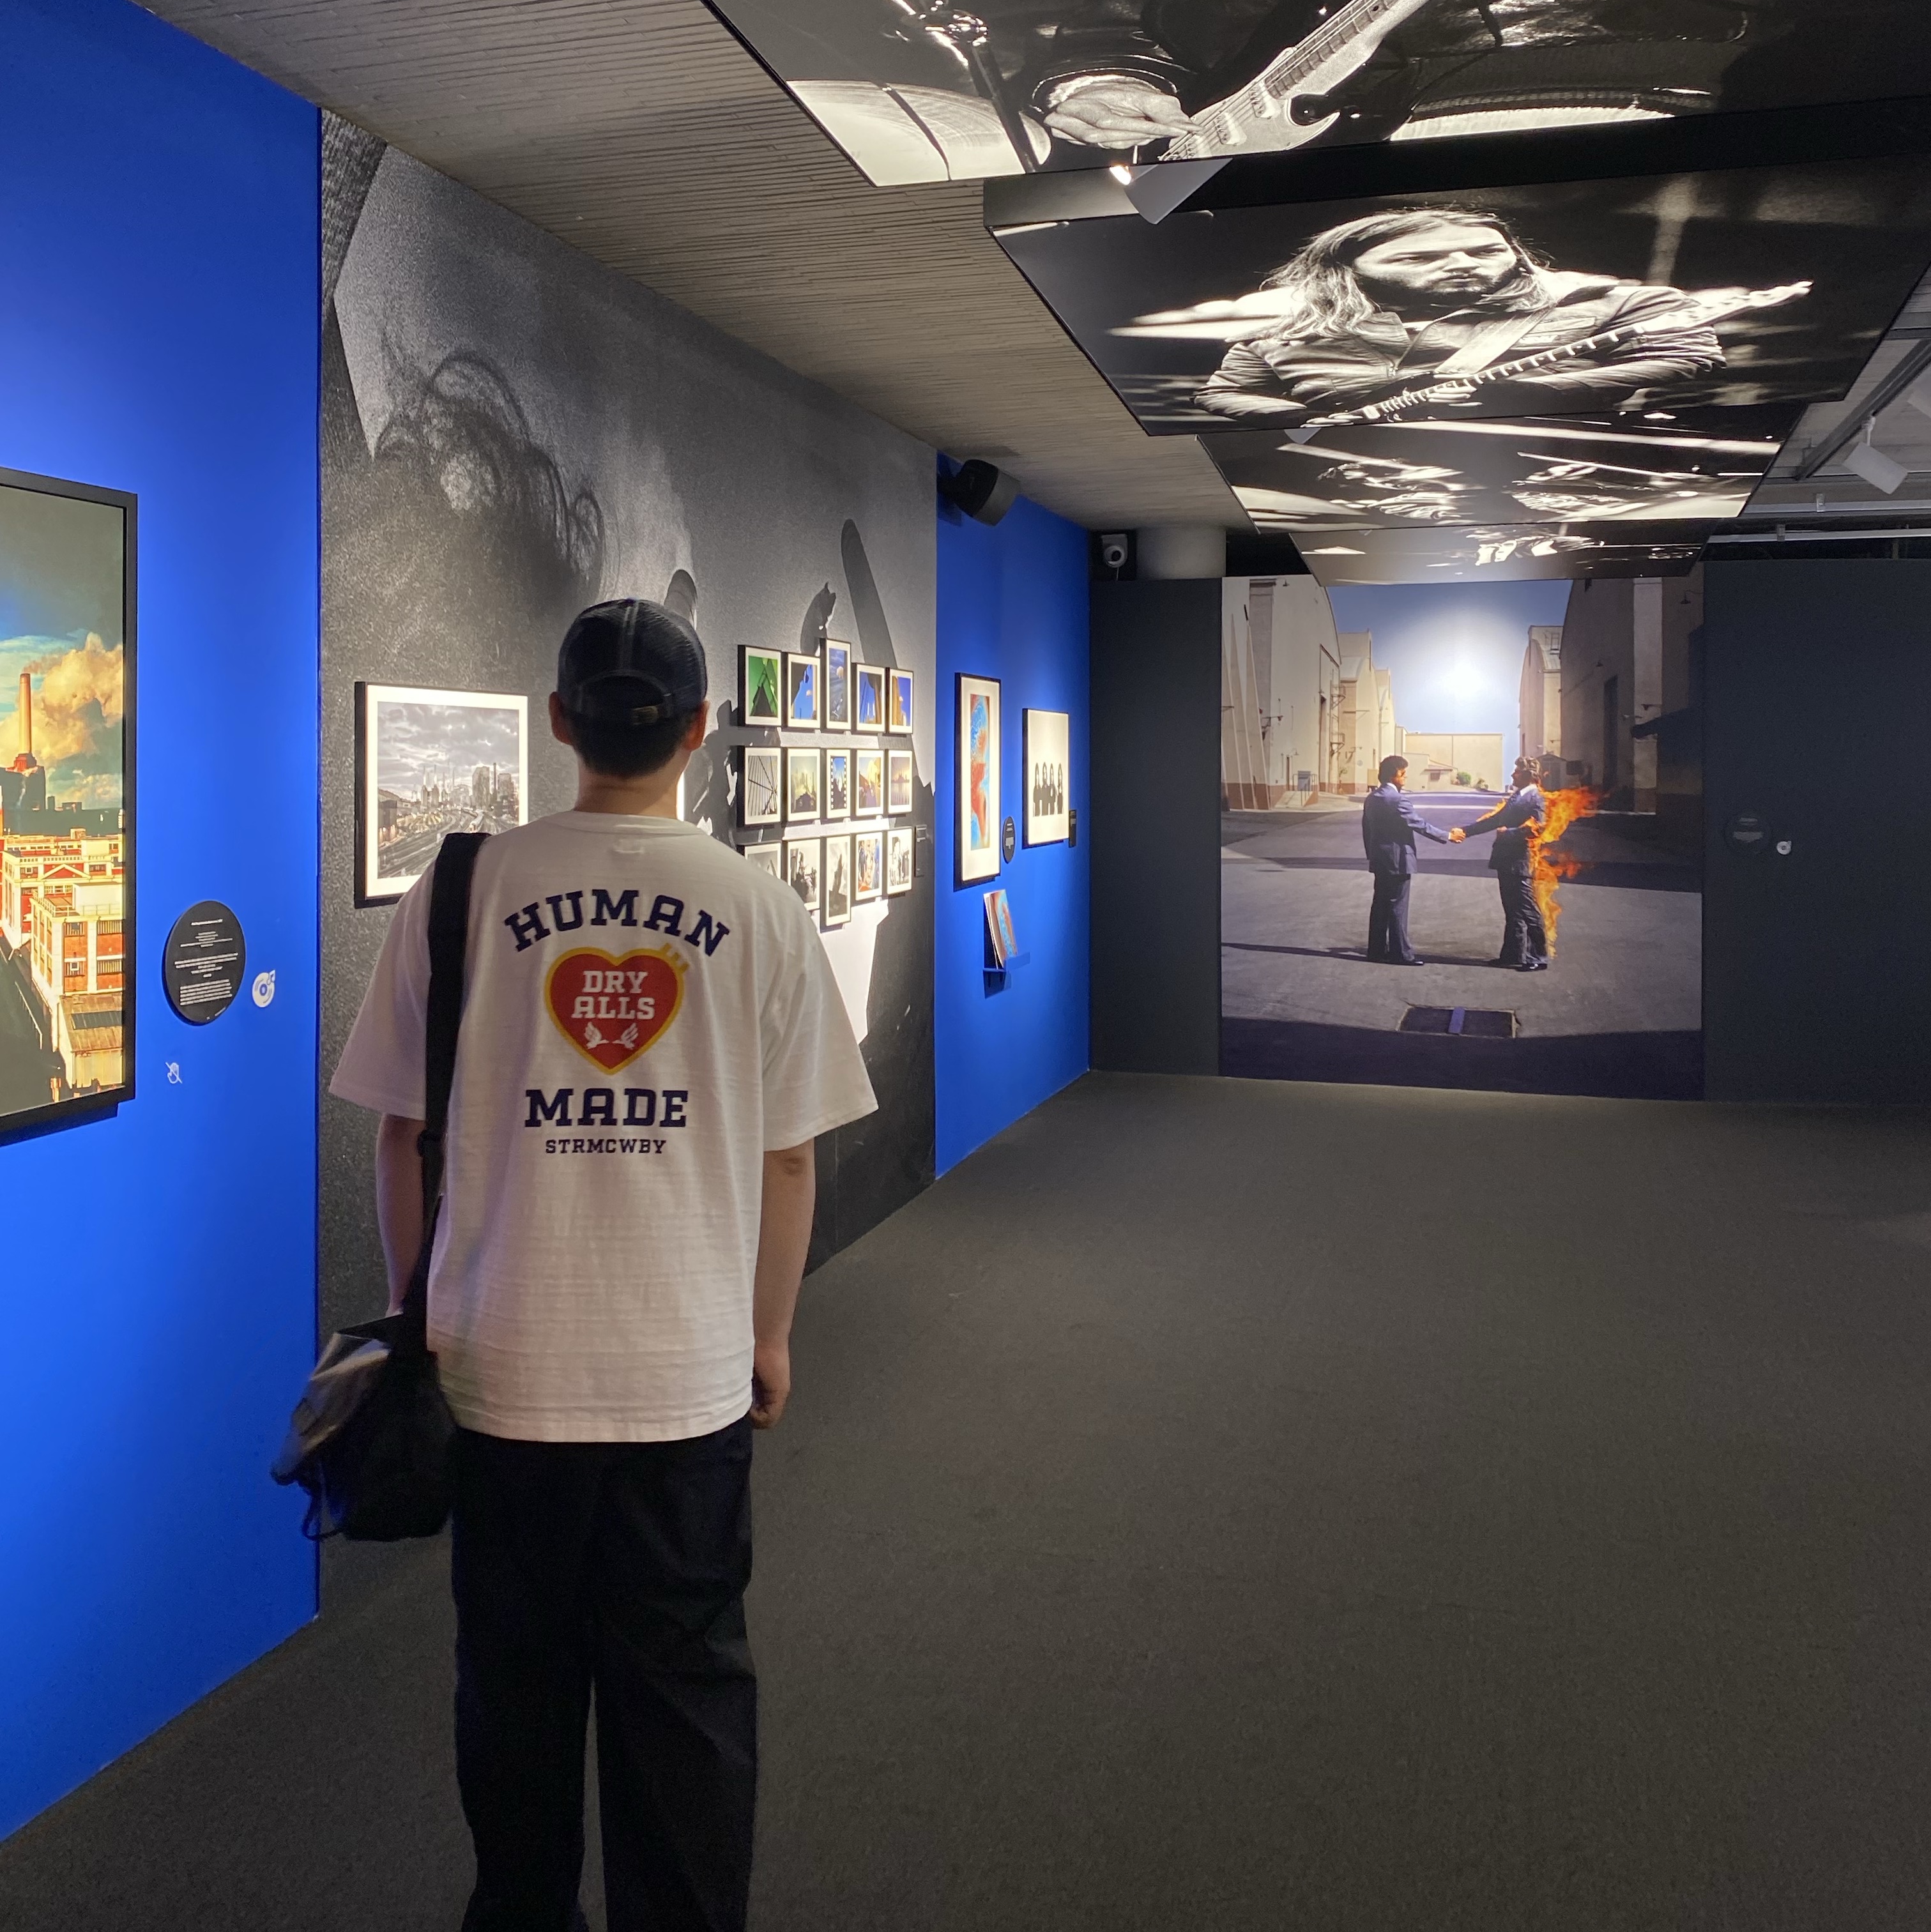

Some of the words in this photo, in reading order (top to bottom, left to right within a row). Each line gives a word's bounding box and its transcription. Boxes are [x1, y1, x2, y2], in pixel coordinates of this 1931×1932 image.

[504, 889, 730, 957] HUMAN
[582, 970, 648, 994] DRY
[571, 996, 655, 1020] ALLS
[524, 1088, 689, 1128] MADE
[545, 1138, 667, 1154] STRMCWBY
